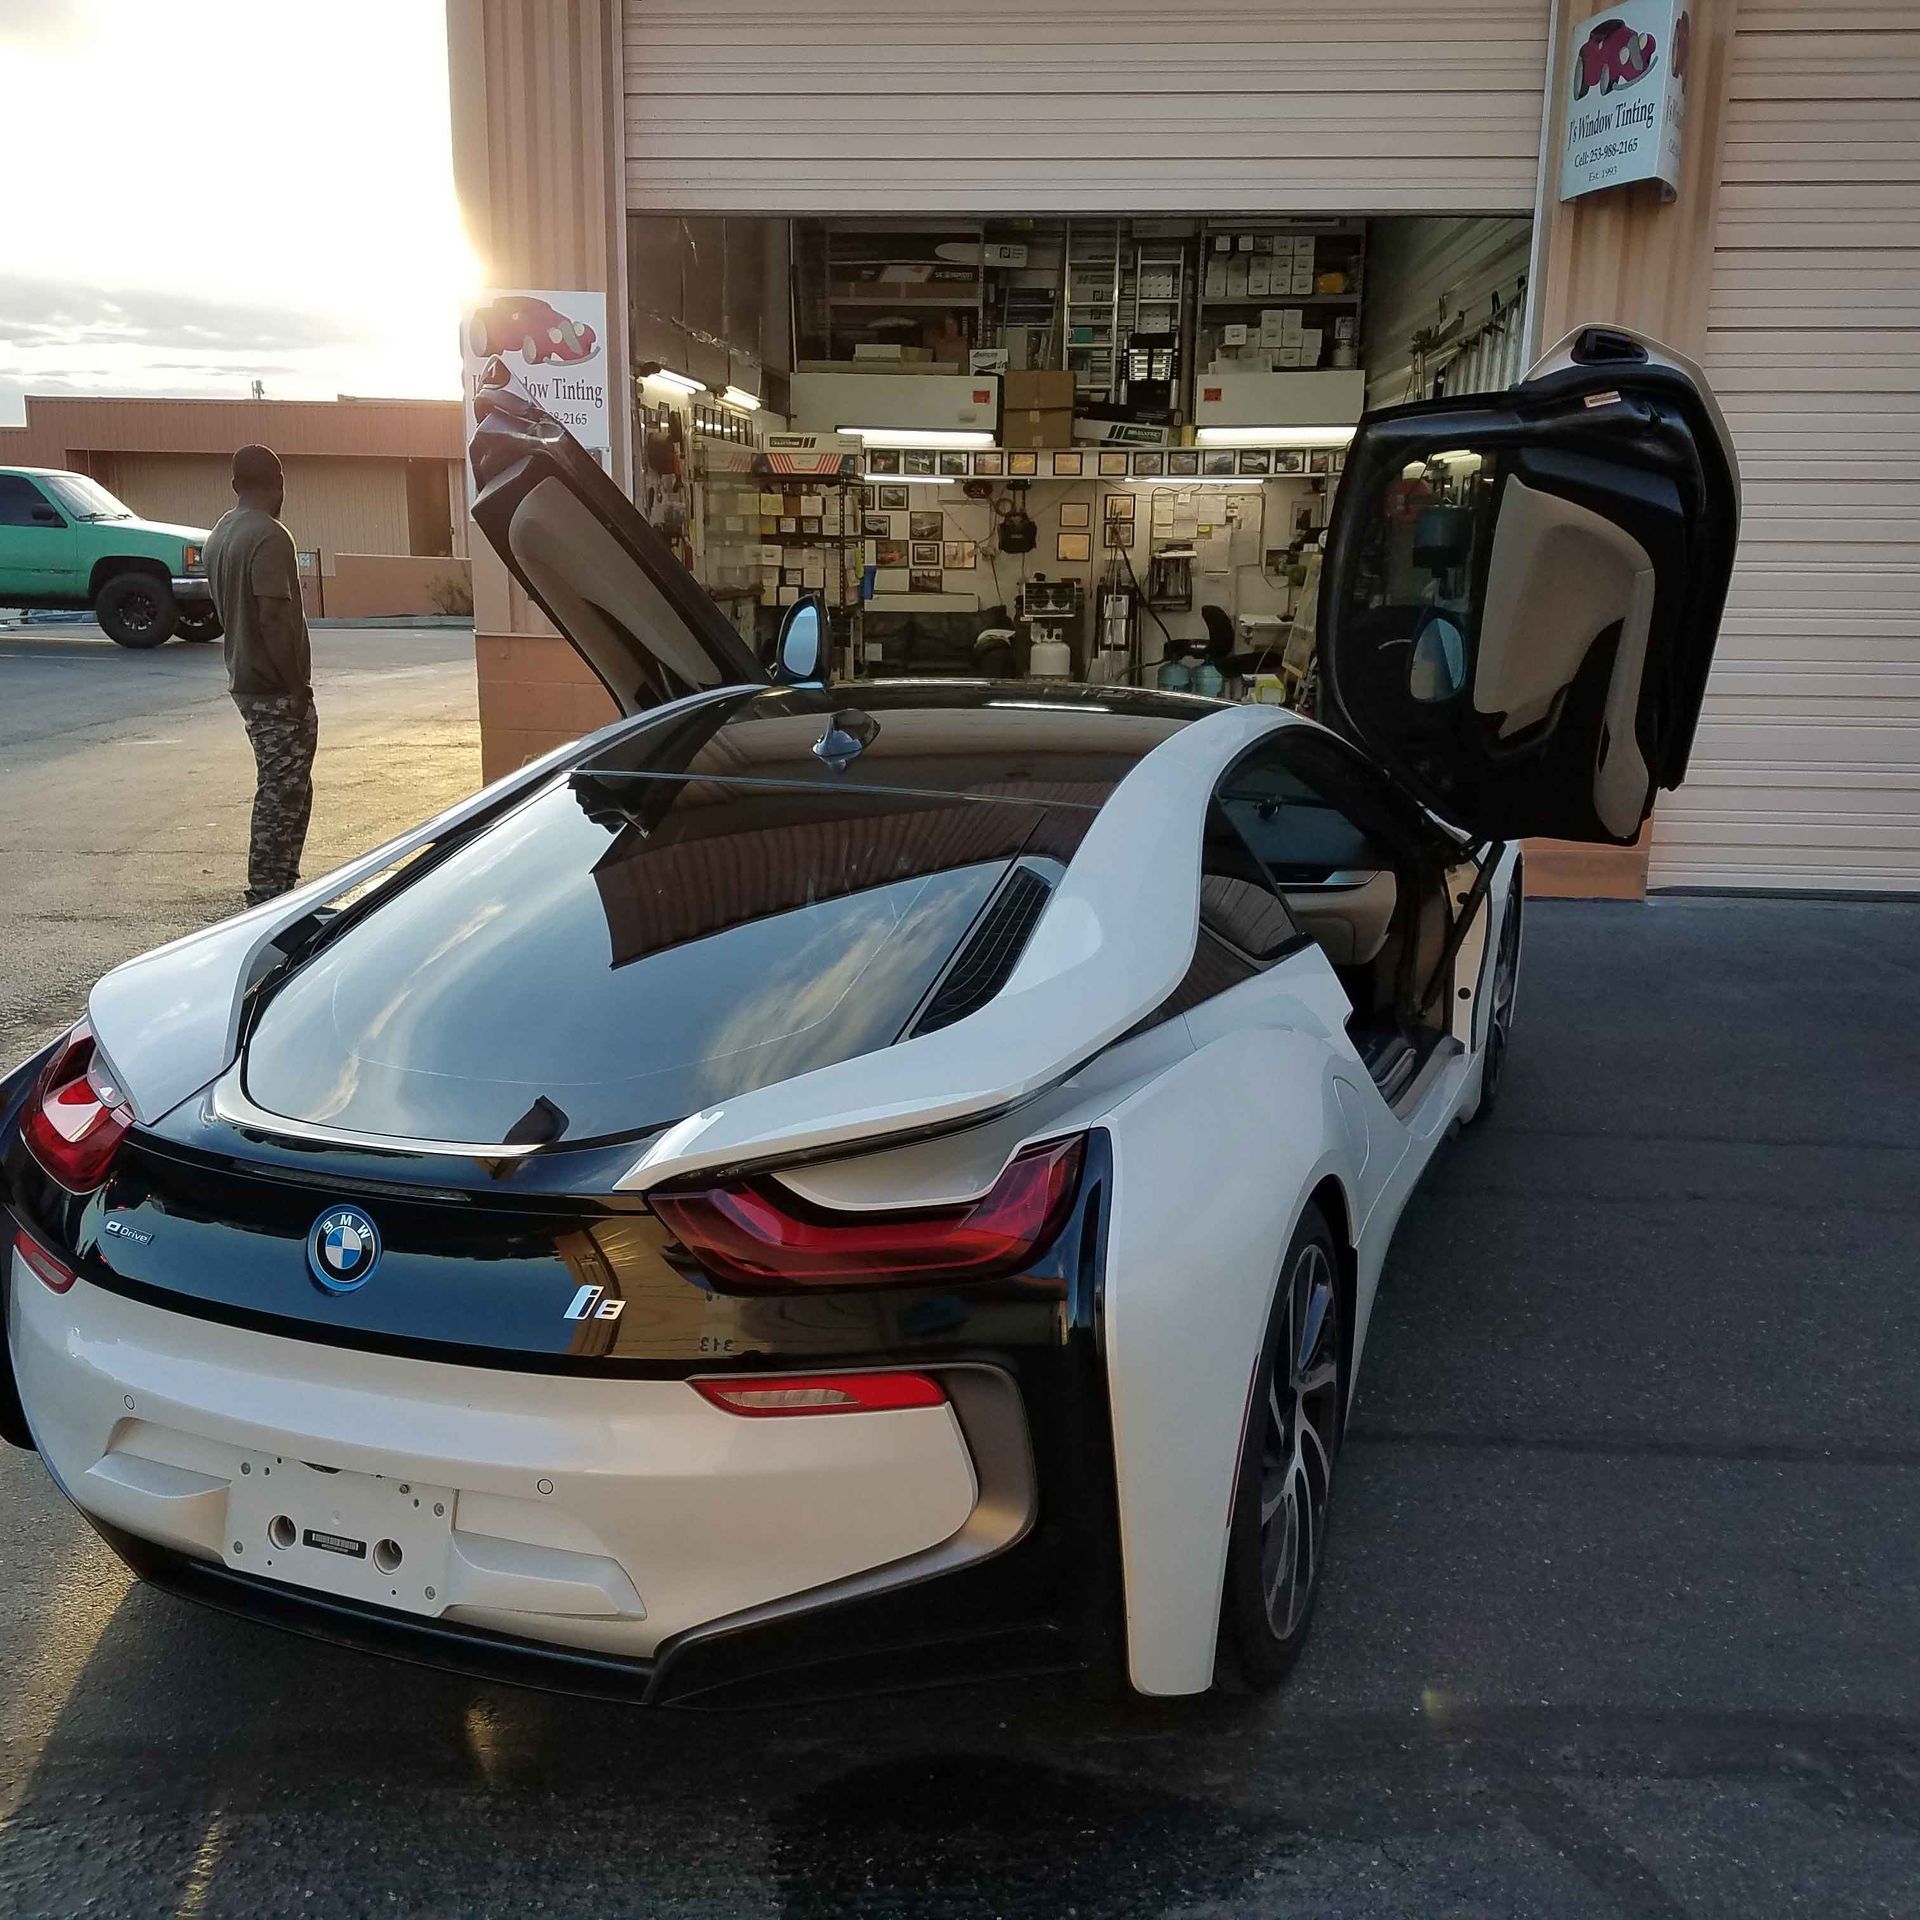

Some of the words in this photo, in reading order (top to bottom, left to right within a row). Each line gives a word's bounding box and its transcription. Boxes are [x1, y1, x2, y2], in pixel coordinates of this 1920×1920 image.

[1579, 110, 1613, 140] Window
[1616, 98, 1655, 128] Tinting
[1574, 154, 1588, 167] Cell:
[1590, 138, 1638, 162] 253-988-2165
[552, 377, 603, 408] Tinting
[323, 1215, 371, 1239] BMW
[563, 1285, 627, 1320] i8
